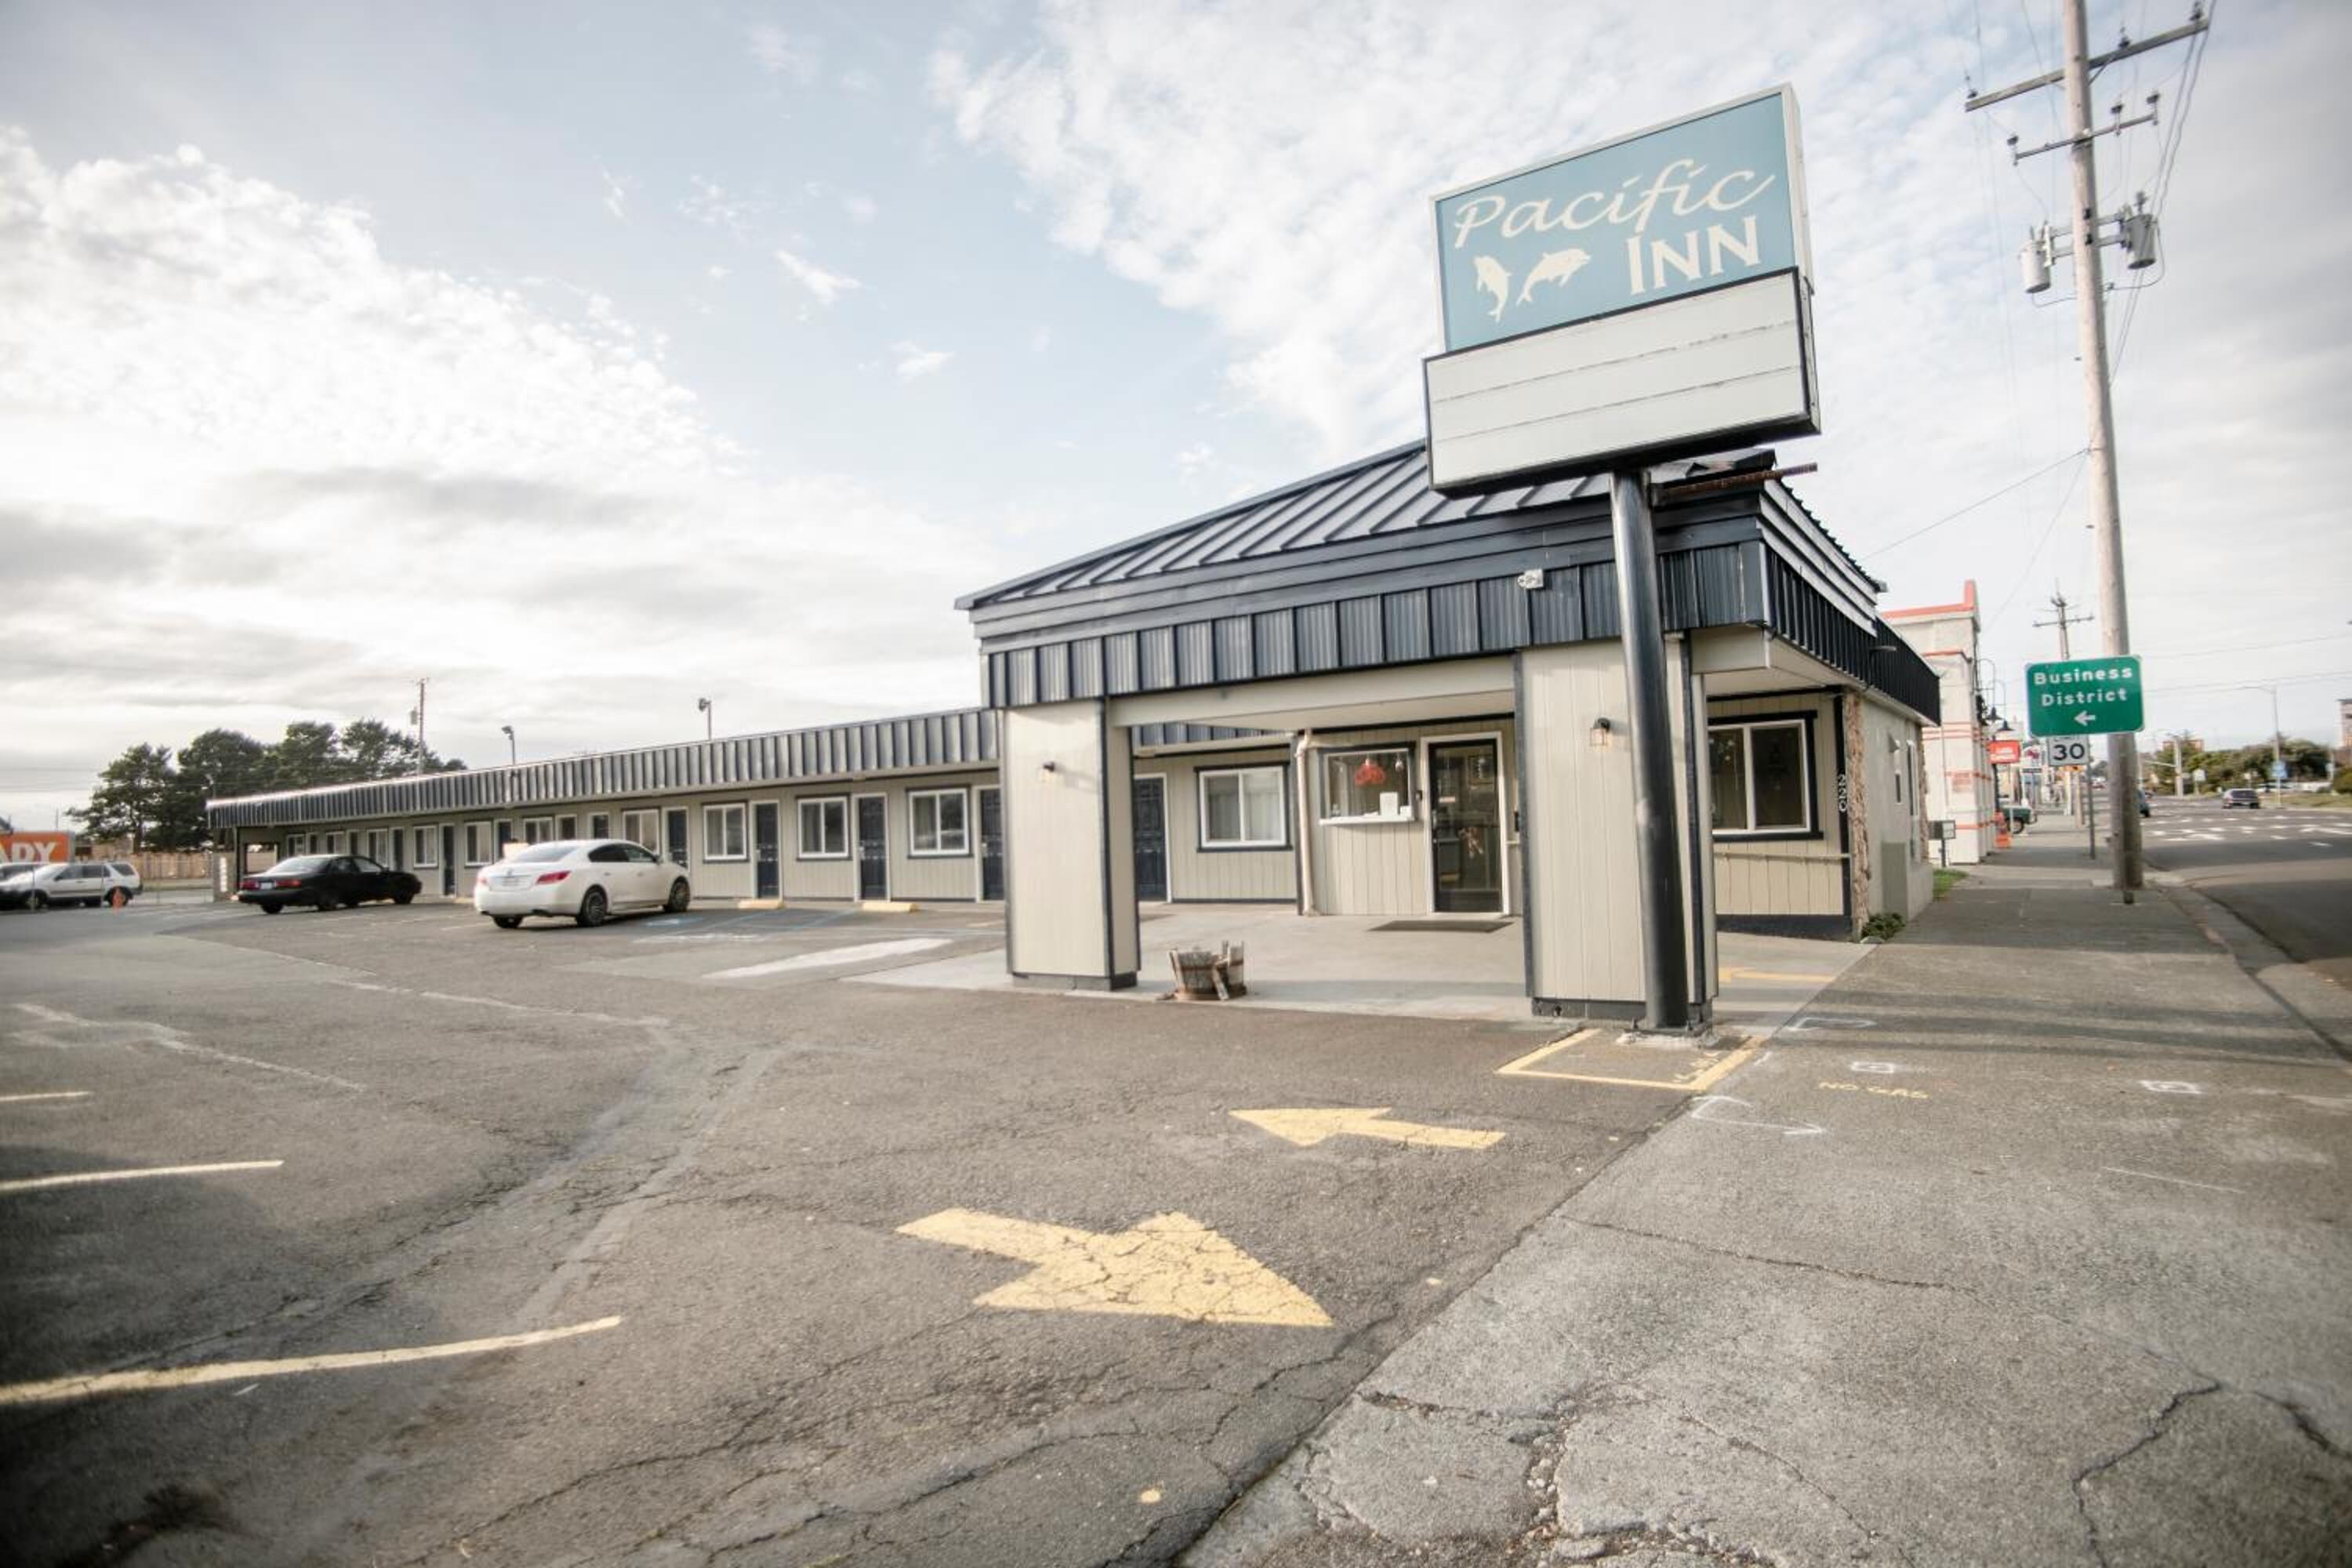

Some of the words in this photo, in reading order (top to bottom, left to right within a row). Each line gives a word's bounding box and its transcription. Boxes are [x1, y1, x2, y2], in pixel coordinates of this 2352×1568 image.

[1454, 159, 1776, 248] Pacific
[1627, 215, 1761, 296] INN
[2033, 666, 2133, 686] Business
[2041, 688, 2127, 707] District
[2053, 742, 2085, 761] 30
